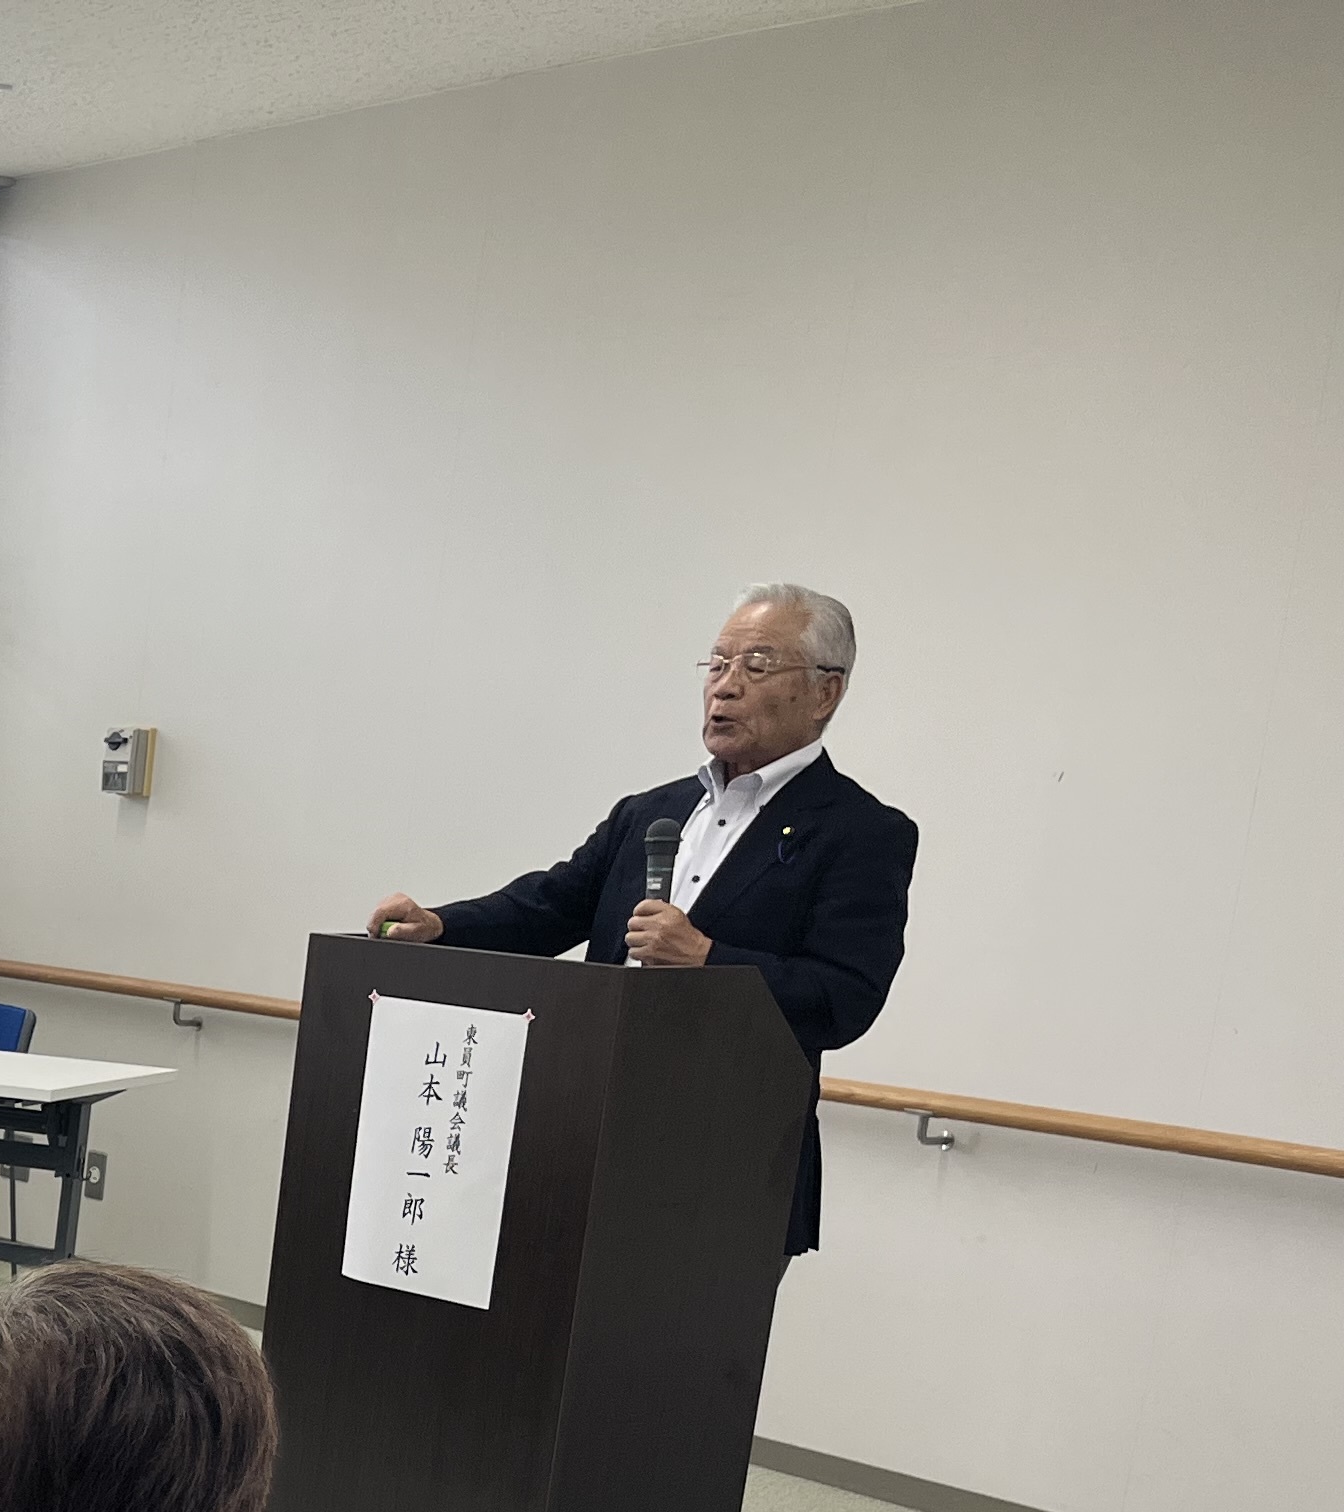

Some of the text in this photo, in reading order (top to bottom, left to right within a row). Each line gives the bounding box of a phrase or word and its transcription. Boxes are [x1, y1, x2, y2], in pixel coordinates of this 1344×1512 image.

[391, 1041, 448, 1276] 山本 陽一郎 様
[443, 1024, 479, 1175] 東員町議会議長
